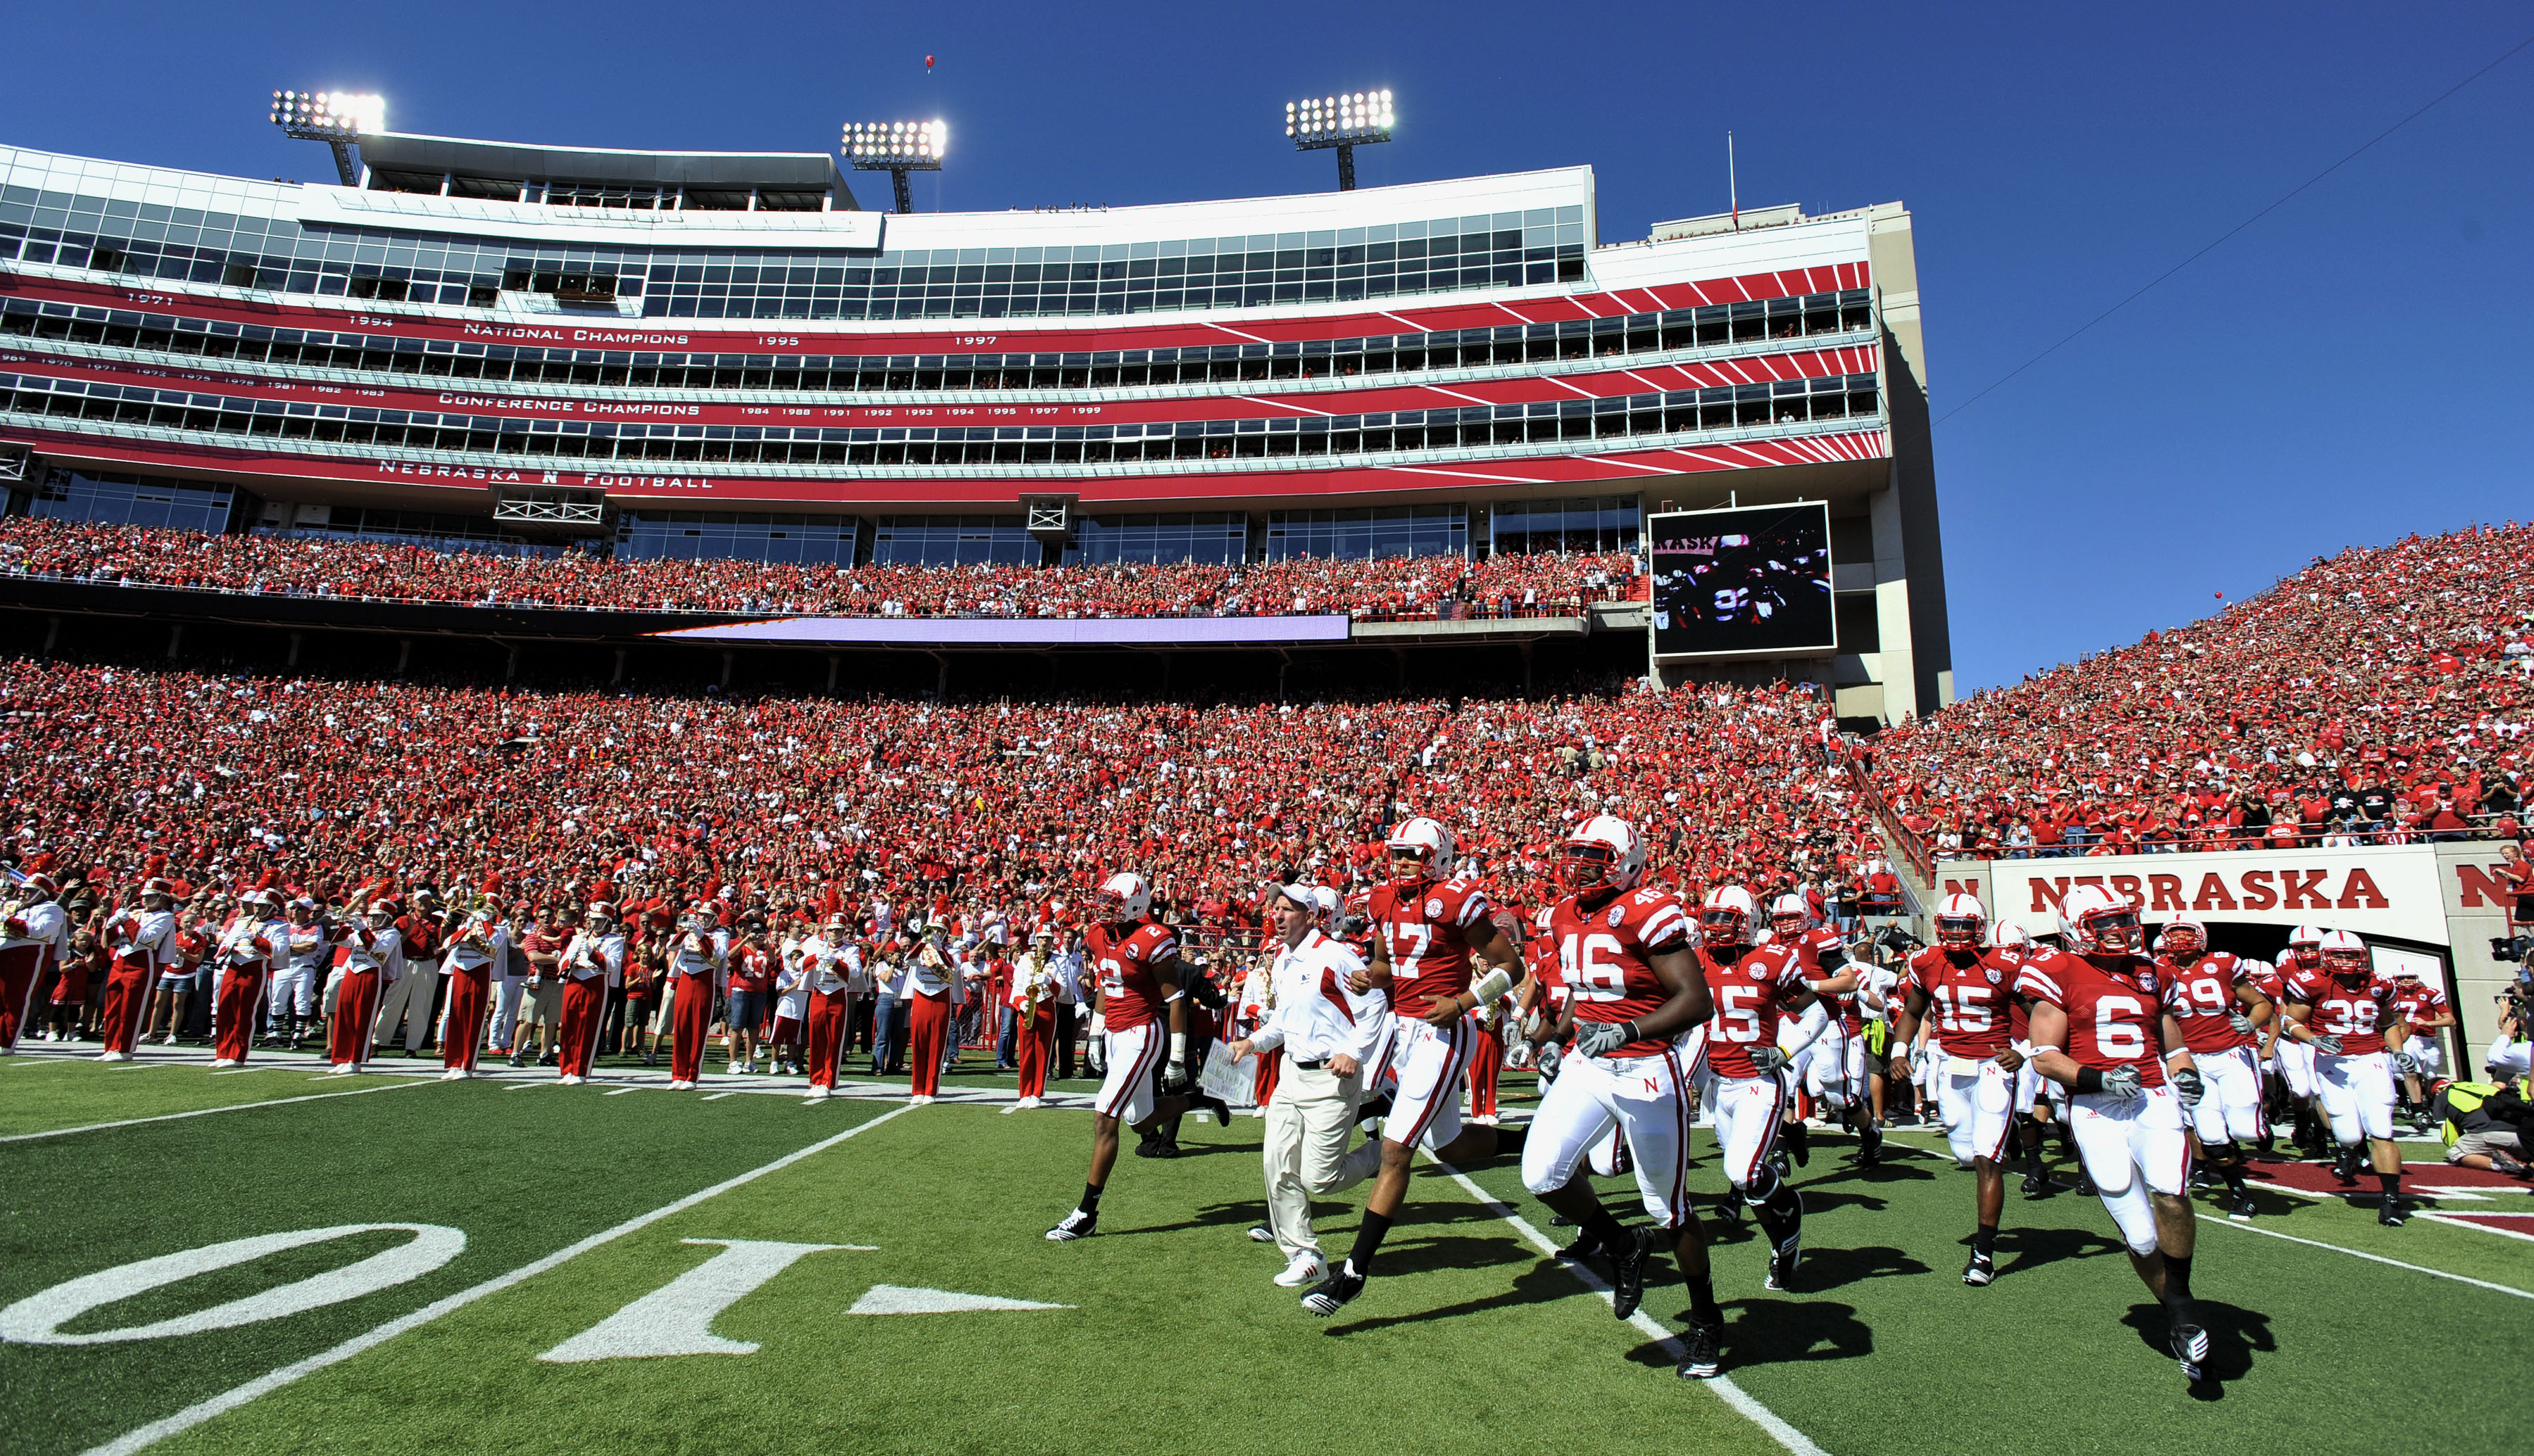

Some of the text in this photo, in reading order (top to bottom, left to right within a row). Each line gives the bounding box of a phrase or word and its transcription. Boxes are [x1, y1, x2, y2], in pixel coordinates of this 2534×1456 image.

[127, 293, 997, 346] 1971 1994 NATIONAL CHAMPIONS 1995 1997
[42, 357, 73, 367] 1970
[88, 363, 116, 372] 1971
[137, 368, 167, 377] 1972
[182, 373, 211, 382] 1975
[225, 378, 254, 386] 1978
[268, 382, 296, 391] 1981
[312, 386, 341, 394] 1982
[439, 393, 574, 412] CONFERENCE
[584, 401, 700, 416] CHAMPIONS
[379, 459, 712, 488] NEBRASKA N FOOTBALL
[1445, 879, 1467, 894] 17
[1633, 887, 1665, 906] 46
[1145, 926, 1161, 937] 2
[1382, 922, 1432, 979] 17
[1765, 944, 1787, 957] 15
[2000, 949, 2019, 965] 15
[741, 955, 768, 979] 43
[1099, 958, 1125, 999] 2
[1560, 933, 1627, 1002] 46
[2296, 970, 2315, 983] 38
[1709, 985, 1760, 1043] 15
[1934, 985, 1992, 1032] 15
[2321, 999, 2379, 1035] 38
[2095, 995, 2145, 1058] 6
[1644, 1077, 1658, 1094] N
